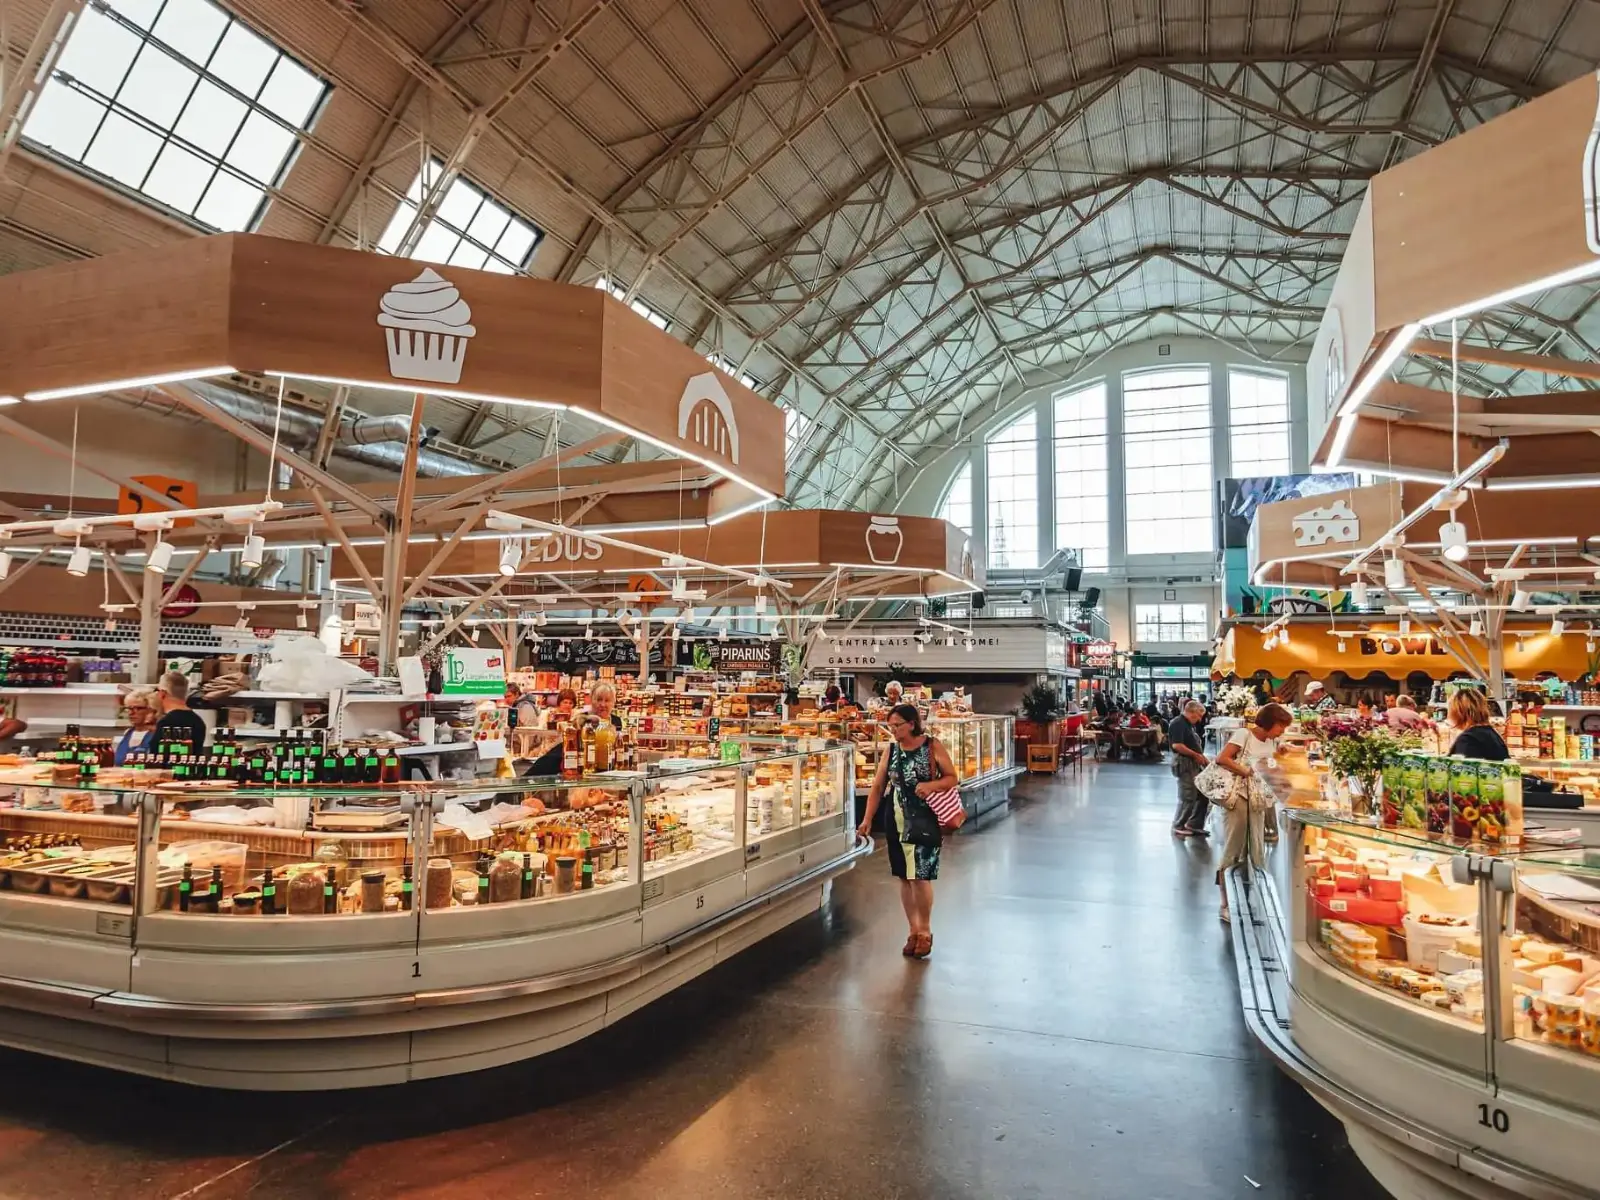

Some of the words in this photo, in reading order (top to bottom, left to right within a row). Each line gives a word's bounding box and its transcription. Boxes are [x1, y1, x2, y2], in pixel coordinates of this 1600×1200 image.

[500, 536, 603, 562] EDUS
[934, 638, 999, 646] WLCOME!
[1087, 645, 1113, 655] PHO
[828, 656, 876, 664] GASTRO
[695, 895, 704, 909] 15
[411, 961, 422, 978] 1
[1478, 1103, 1509, 1133] 10
